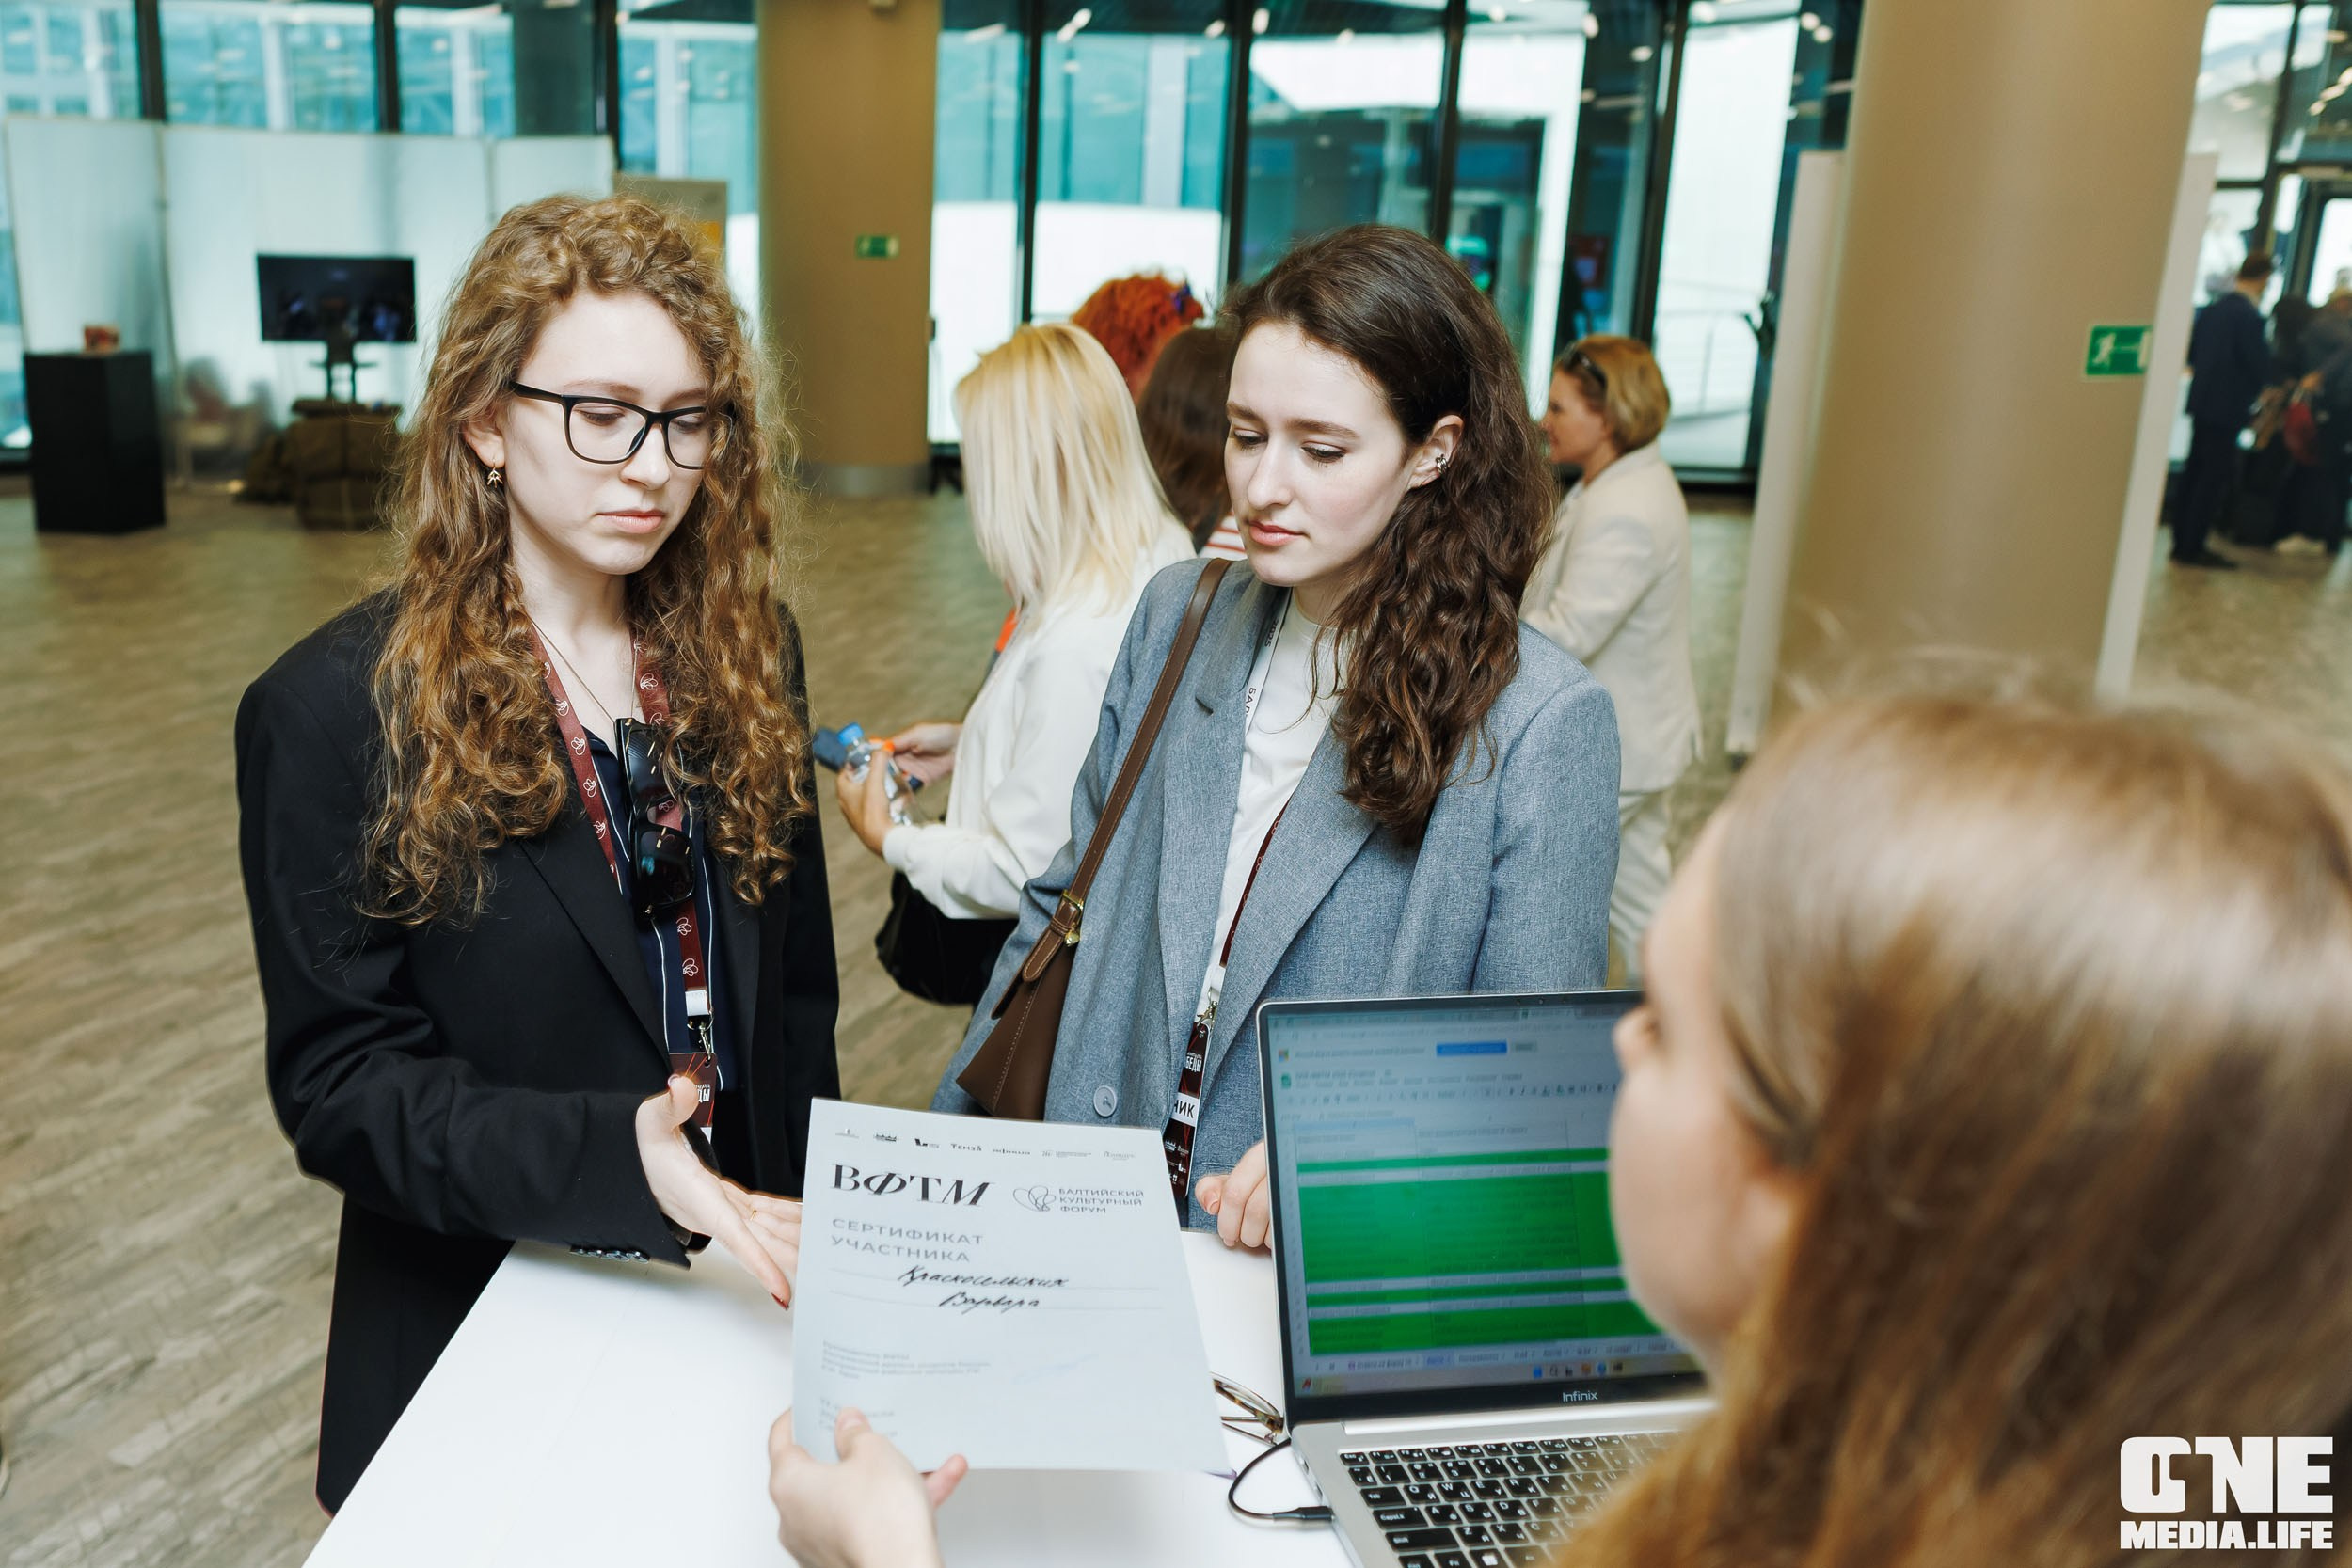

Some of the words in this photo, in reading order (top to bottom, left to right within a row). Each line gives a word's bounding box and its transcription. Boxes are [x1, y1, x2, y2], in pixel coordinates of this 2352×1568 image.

[830, 1163, 996, 1207] ВФТМ
[1058, 1187, 1145, 1197] БАЛТИЙСКИЙ
[1059, 1196, 1143, 1207] КУЛЬТУРНЫЙ
[831, 1218, 984, 1245] СЕРТИФИКАТ
[831, 1235, 971, 1262] УЧАСТНИКА
[1562, 1390, 1598, 1402] Infinix
